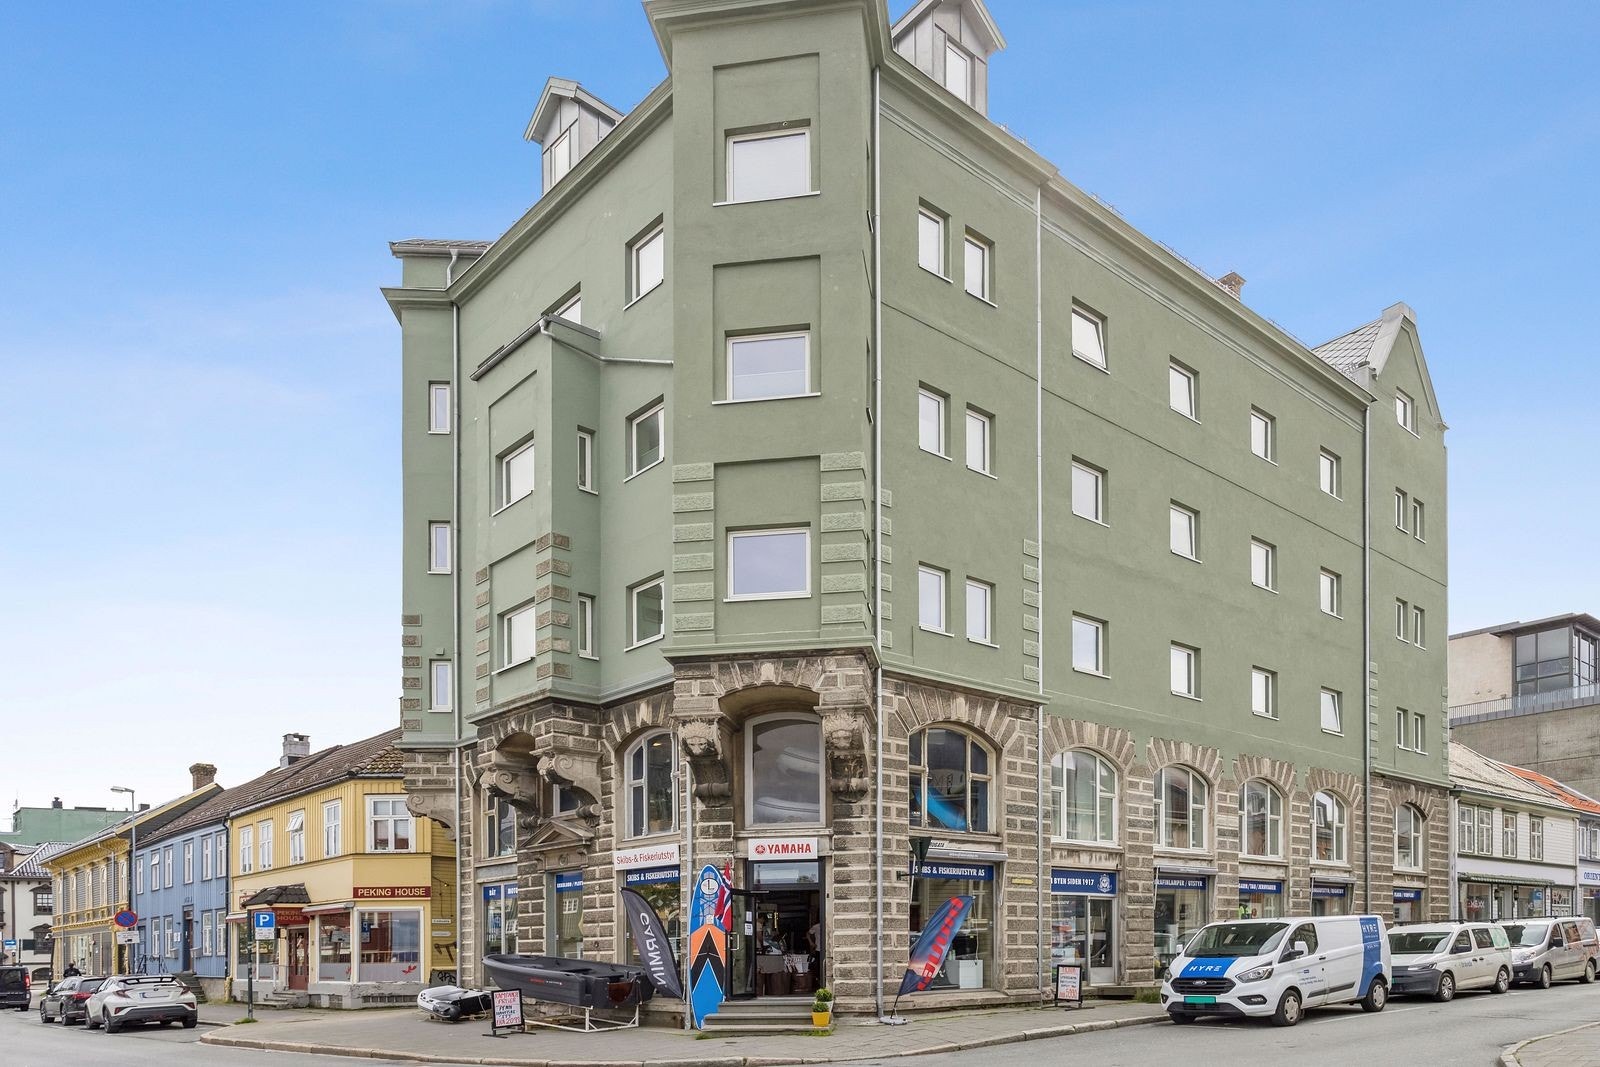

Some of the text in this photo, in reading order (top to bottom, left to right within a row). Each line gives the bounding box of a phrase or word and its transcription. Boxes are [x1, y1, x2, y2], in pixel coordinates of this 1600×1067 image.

[767, 843, 812, 854] YAMAHA
[639, 850, 675, 862] Fiskeriutstyr
[627, 873, 640, 882] SKIBS
[645, 870, 679, 881] FISKERIUTSTYR
[939, 867, 977, 876] FISKERIUTSTYR
[1082, 878, 1095, 886] 1917
[358, 888, 426, 897] PEKING HOUSE
[259, 914, 270, 926] P
